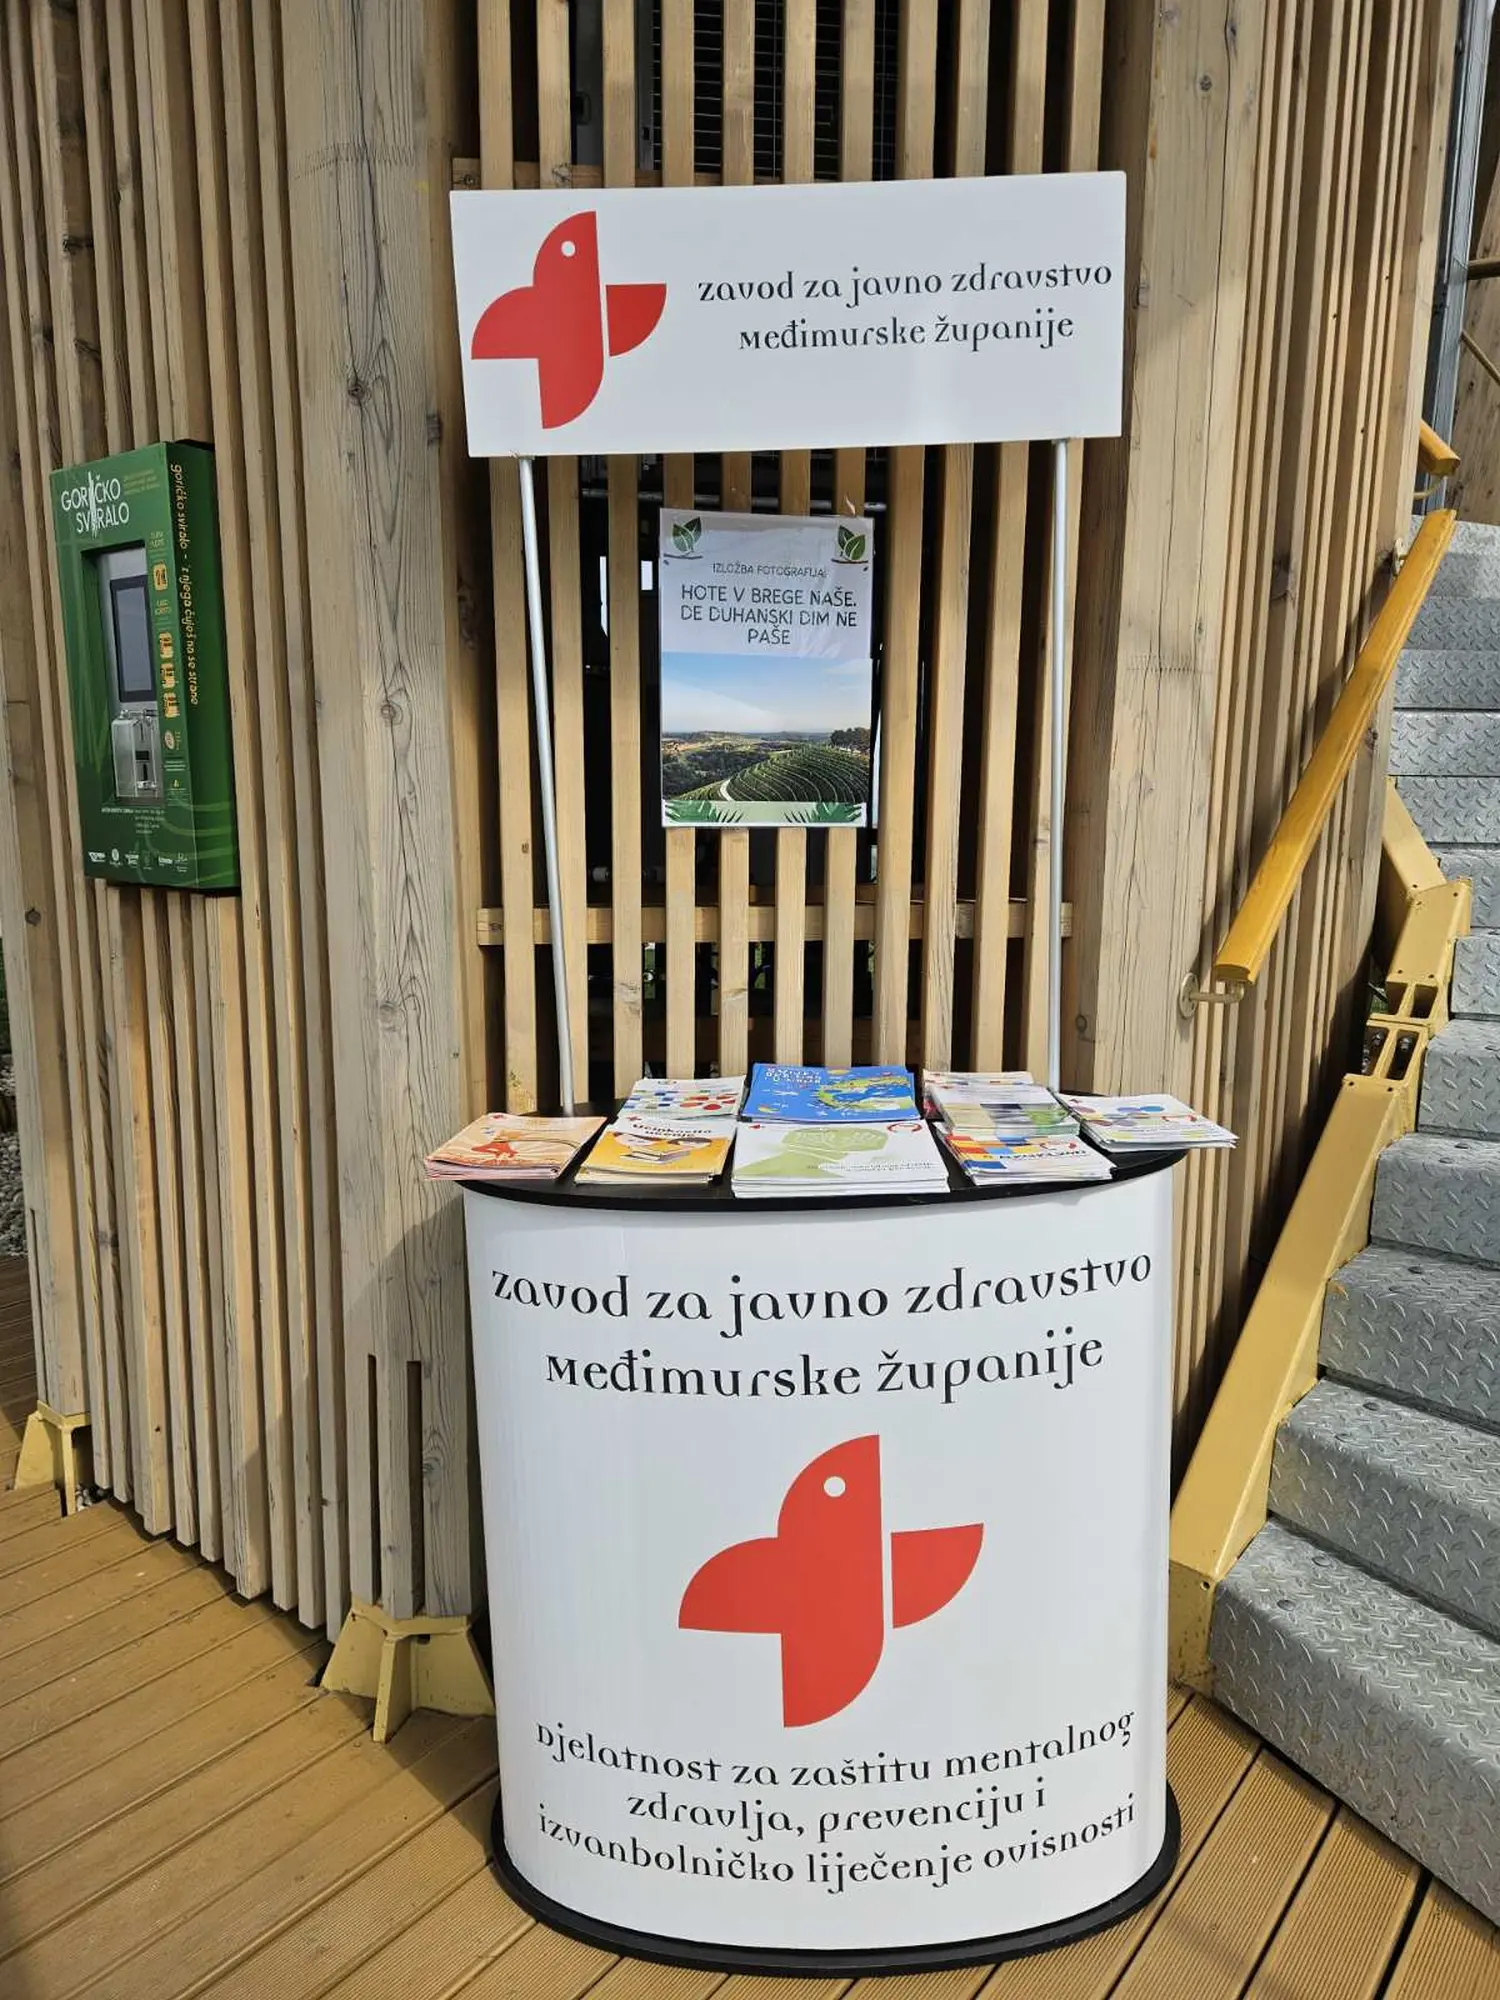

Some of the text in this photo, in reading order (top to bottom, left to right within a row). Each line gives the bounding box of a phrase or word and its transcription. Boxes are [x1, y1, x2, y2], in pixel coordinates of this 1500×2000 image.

[698, 262, 1113, 309] zavod za javno zdravstvo
[740, 307, 1074, 352] Međimurske županije
[169, 463, 188, 510] goričko
[177, 512, 191, 550] sviralo
[712, 561, 754, 574] IZLOŽBA
[680, 605, 857, 627] DE DUHANSKI DIM NE
[681, 584, 857, 607] HOTE V BREGE NAŠE.
[747, 625, 791, 645] PAŠE
[492, 1254, 1151, 1339] zavod za javno zdravstvo
[546, 1326, 1102, 1405] Međimurske županije
[537, 1711, 1134, 1787] Djelatnost za zaštitu mentalnog
[627, 1776, 1046, 1843] zdravlja, prevenciju i
[539, 1793, 1134, 1895] izvanbolničko liječenje ovisnosti
